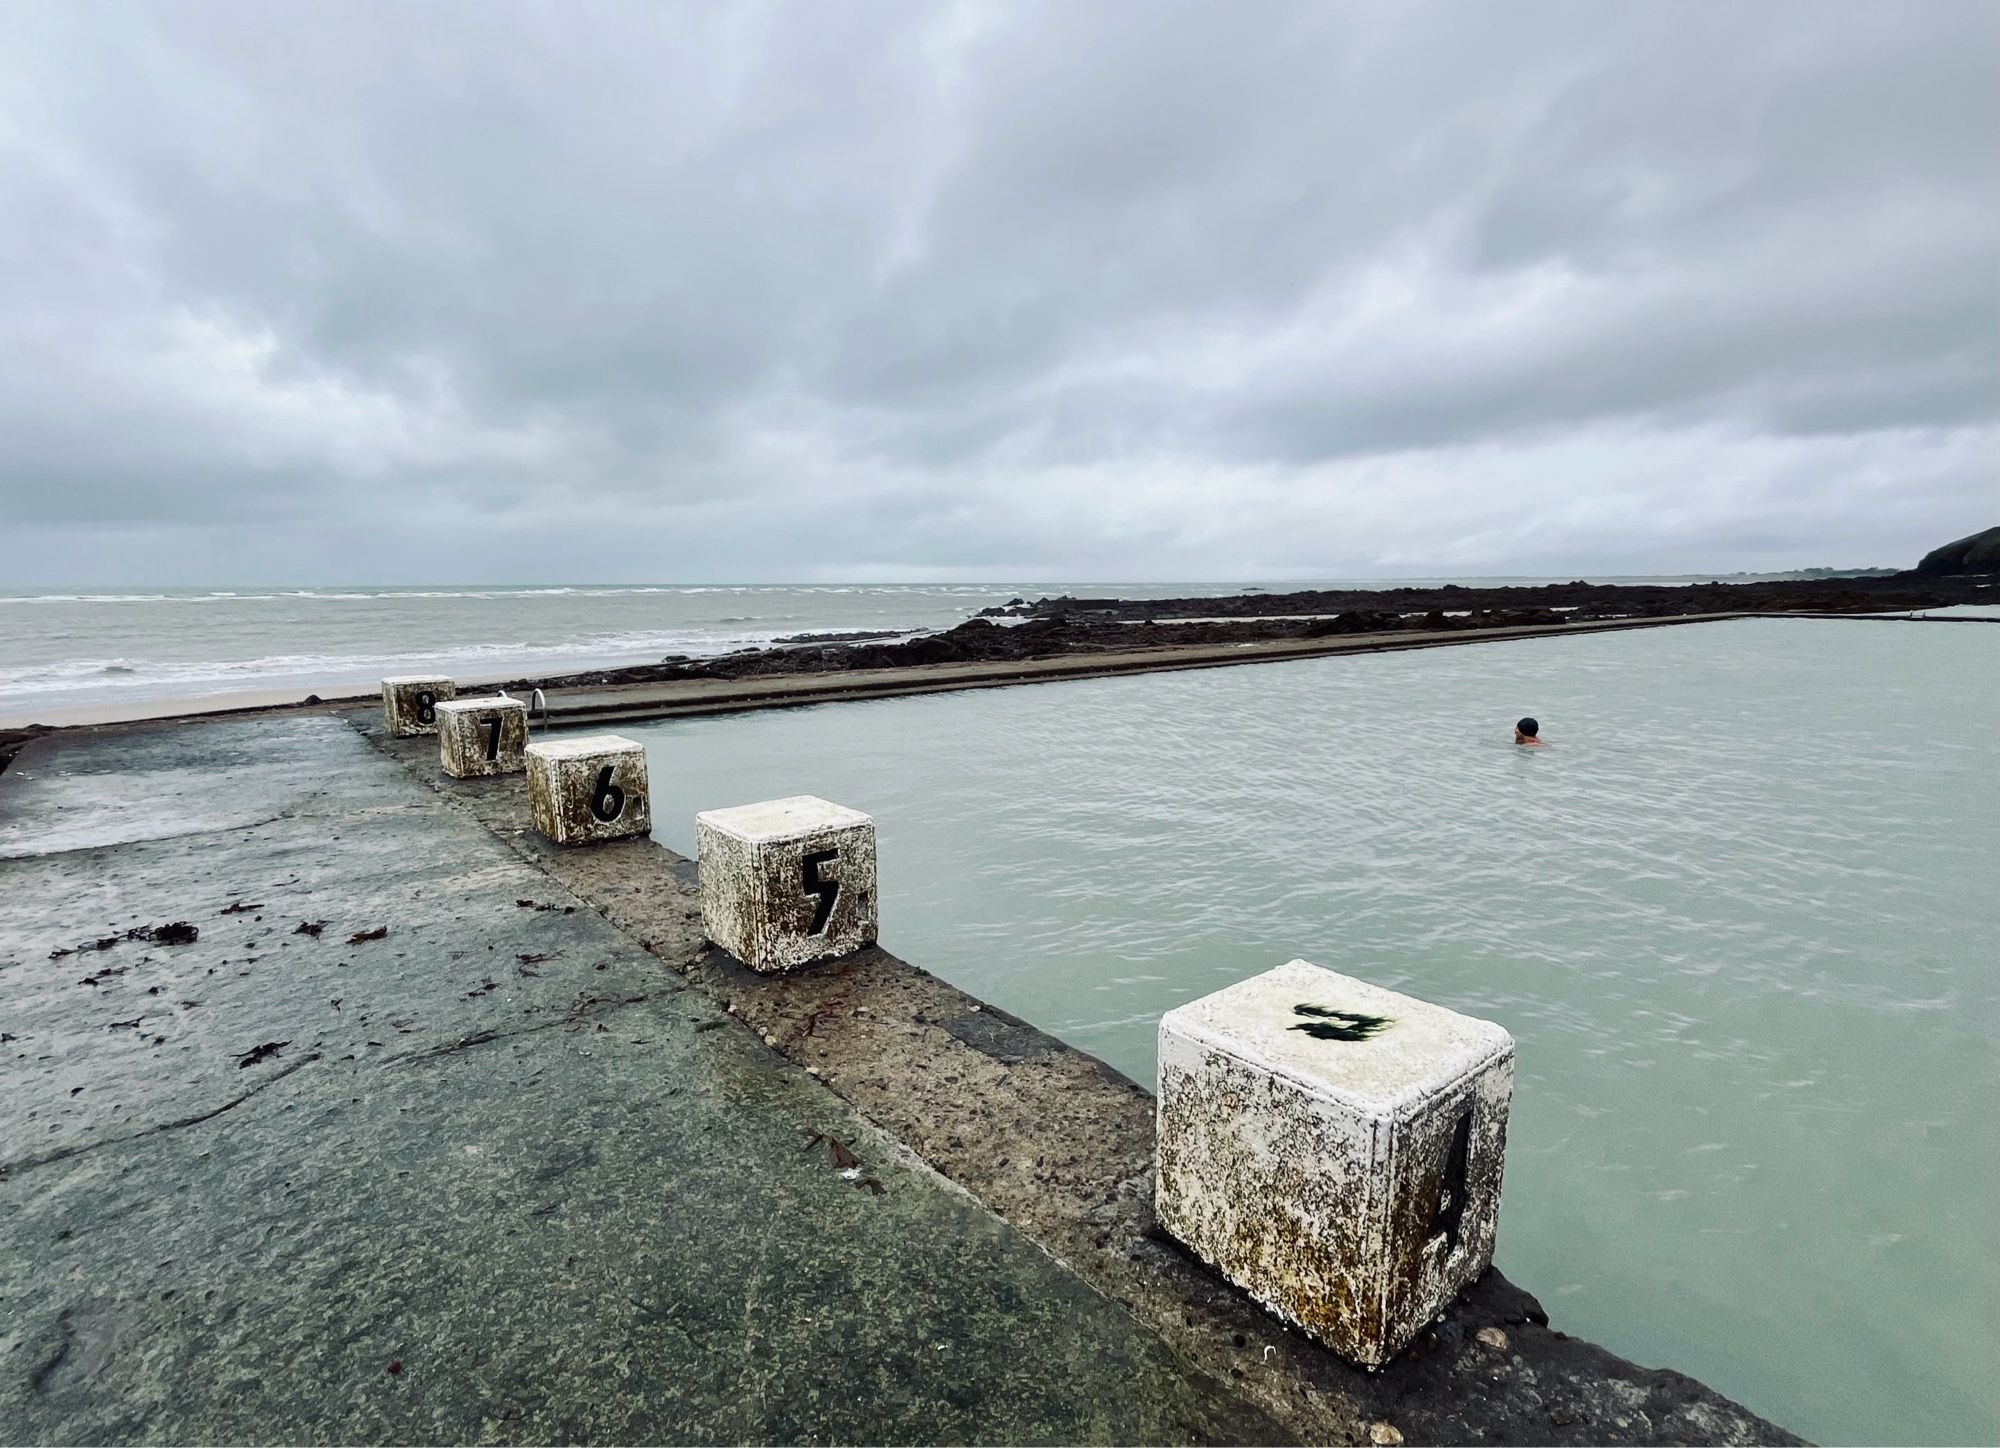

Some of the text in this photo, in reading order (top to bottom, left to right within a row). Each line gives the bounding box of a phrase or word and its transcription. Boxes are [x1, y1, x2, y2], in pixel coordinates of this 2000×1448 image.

[414, 691, 435, 724] 8
[480, 717, 504, 761] 7
[591, 766, 626, 822] 6
[802, 848, 840, 936] 5
